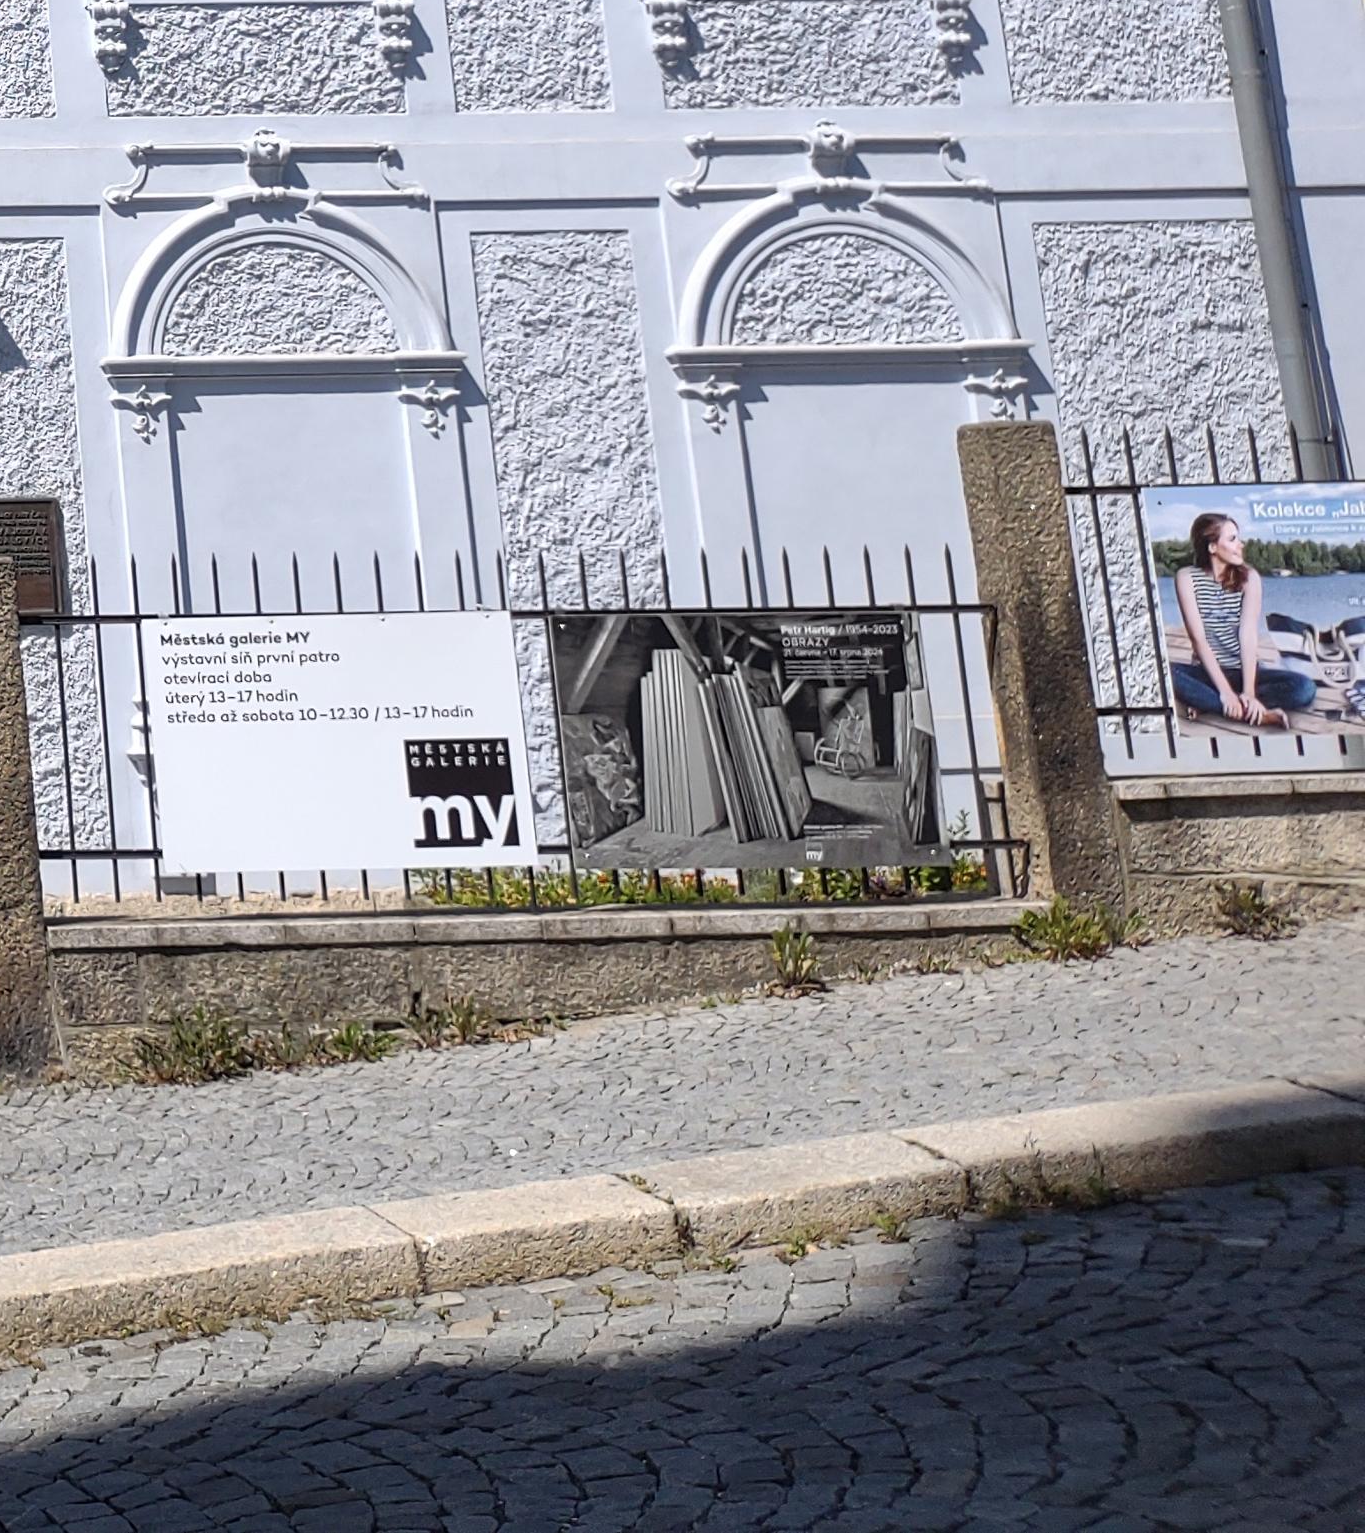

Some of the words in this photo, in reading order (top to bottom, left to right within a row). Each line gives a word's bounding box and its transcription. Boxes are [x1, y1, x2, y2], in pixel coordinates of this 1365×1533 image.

[1252, 501, 1326, 518] Kolekce
[160, 633, 225, 646] Městská
[229, 631, 282, 648] galerie
[286, 632, 310, 643] MY
[782, 637, 829, 647] OBRAZY
[161, 651, 227, 668] výstavní
[231, 651, 253, 664] síň
[257, 650, 295, 667] první
[299, 651, 340, 666] patro
[163, 670, 229, 685] otevírací
[234, 671, 272, 683] doba
[165, 691, 205, 708] úterý
[256, 689, 299, 702] hodin
[167, 710, 216, 724] středa
[220, 710, 238, 722] až
[242, 709, 295, 722] sobota
[431, 704, 474, 718] hodin
[409, 741, 505, 755] MĚSTSKÁ
[410, 755, 507, 767] GALERIE
[409, 794, 515, 848] my
